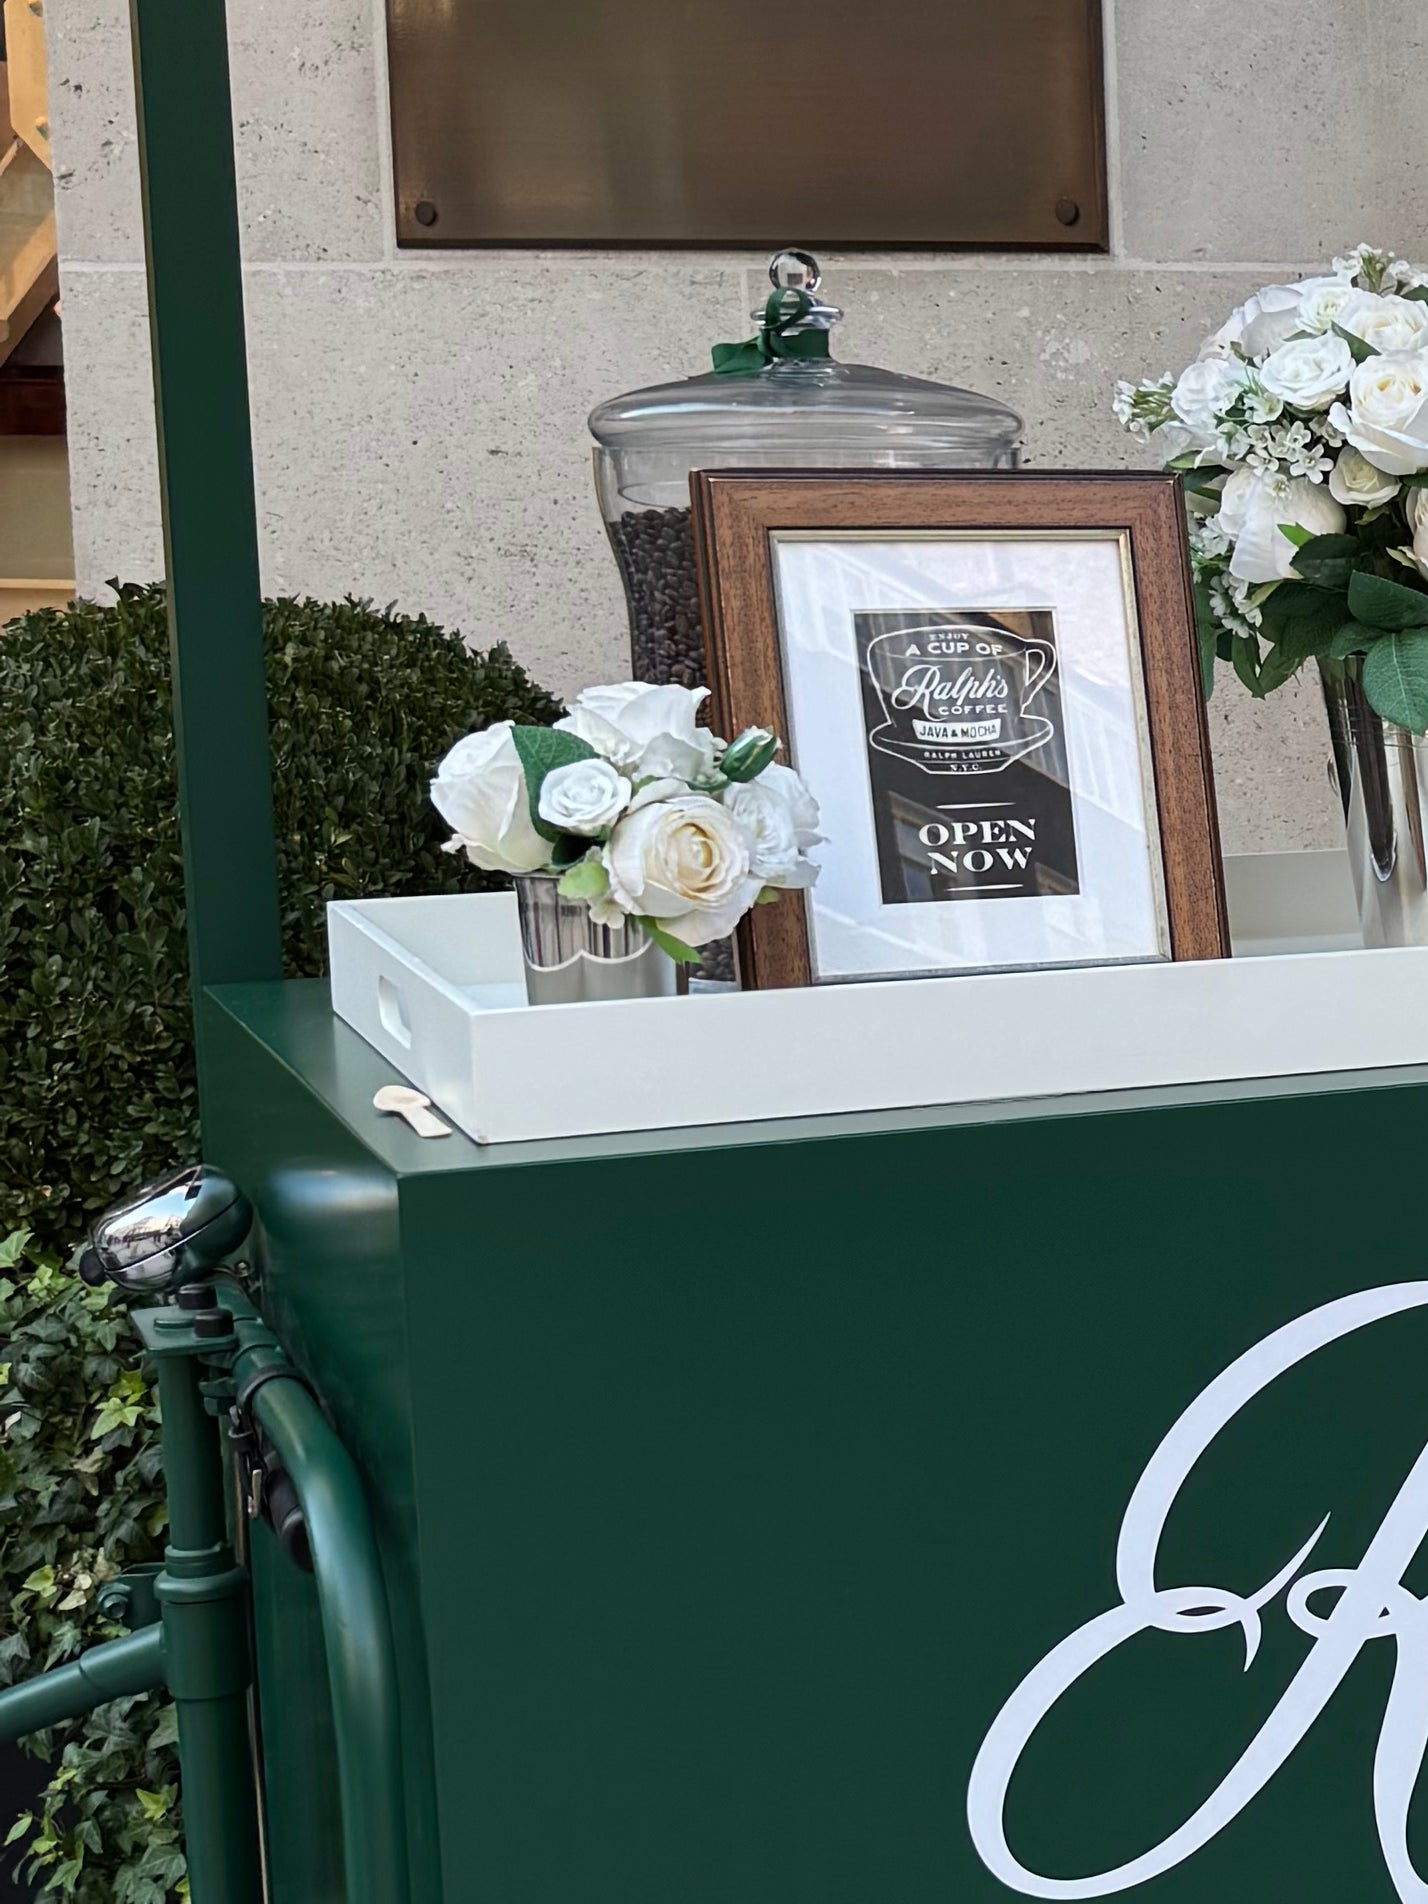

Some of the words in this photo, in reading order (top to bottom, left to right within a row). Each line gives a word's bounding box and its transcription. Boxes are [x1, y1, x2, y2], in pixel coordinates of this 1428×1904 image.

[929, 632, 970, 642] ENJOY
[905, 643, 921, 656] A
[927, 642, 970, 654] CUP
[975, 642, 1004, 656] OF
[891, 664, 1009, 722] Ralph's
[938, 704, 1009, 716] COFFEE
[919, 726, 948, 738] JAVA
[961, 724, 998, 739] MOCHA
[923, 751, 958, 759] RALPH
[962, 749, 1002, 758] LAUREN
[918, 817, 1037, 847] OPEN
[929, 846, 1034, 876] NOW
